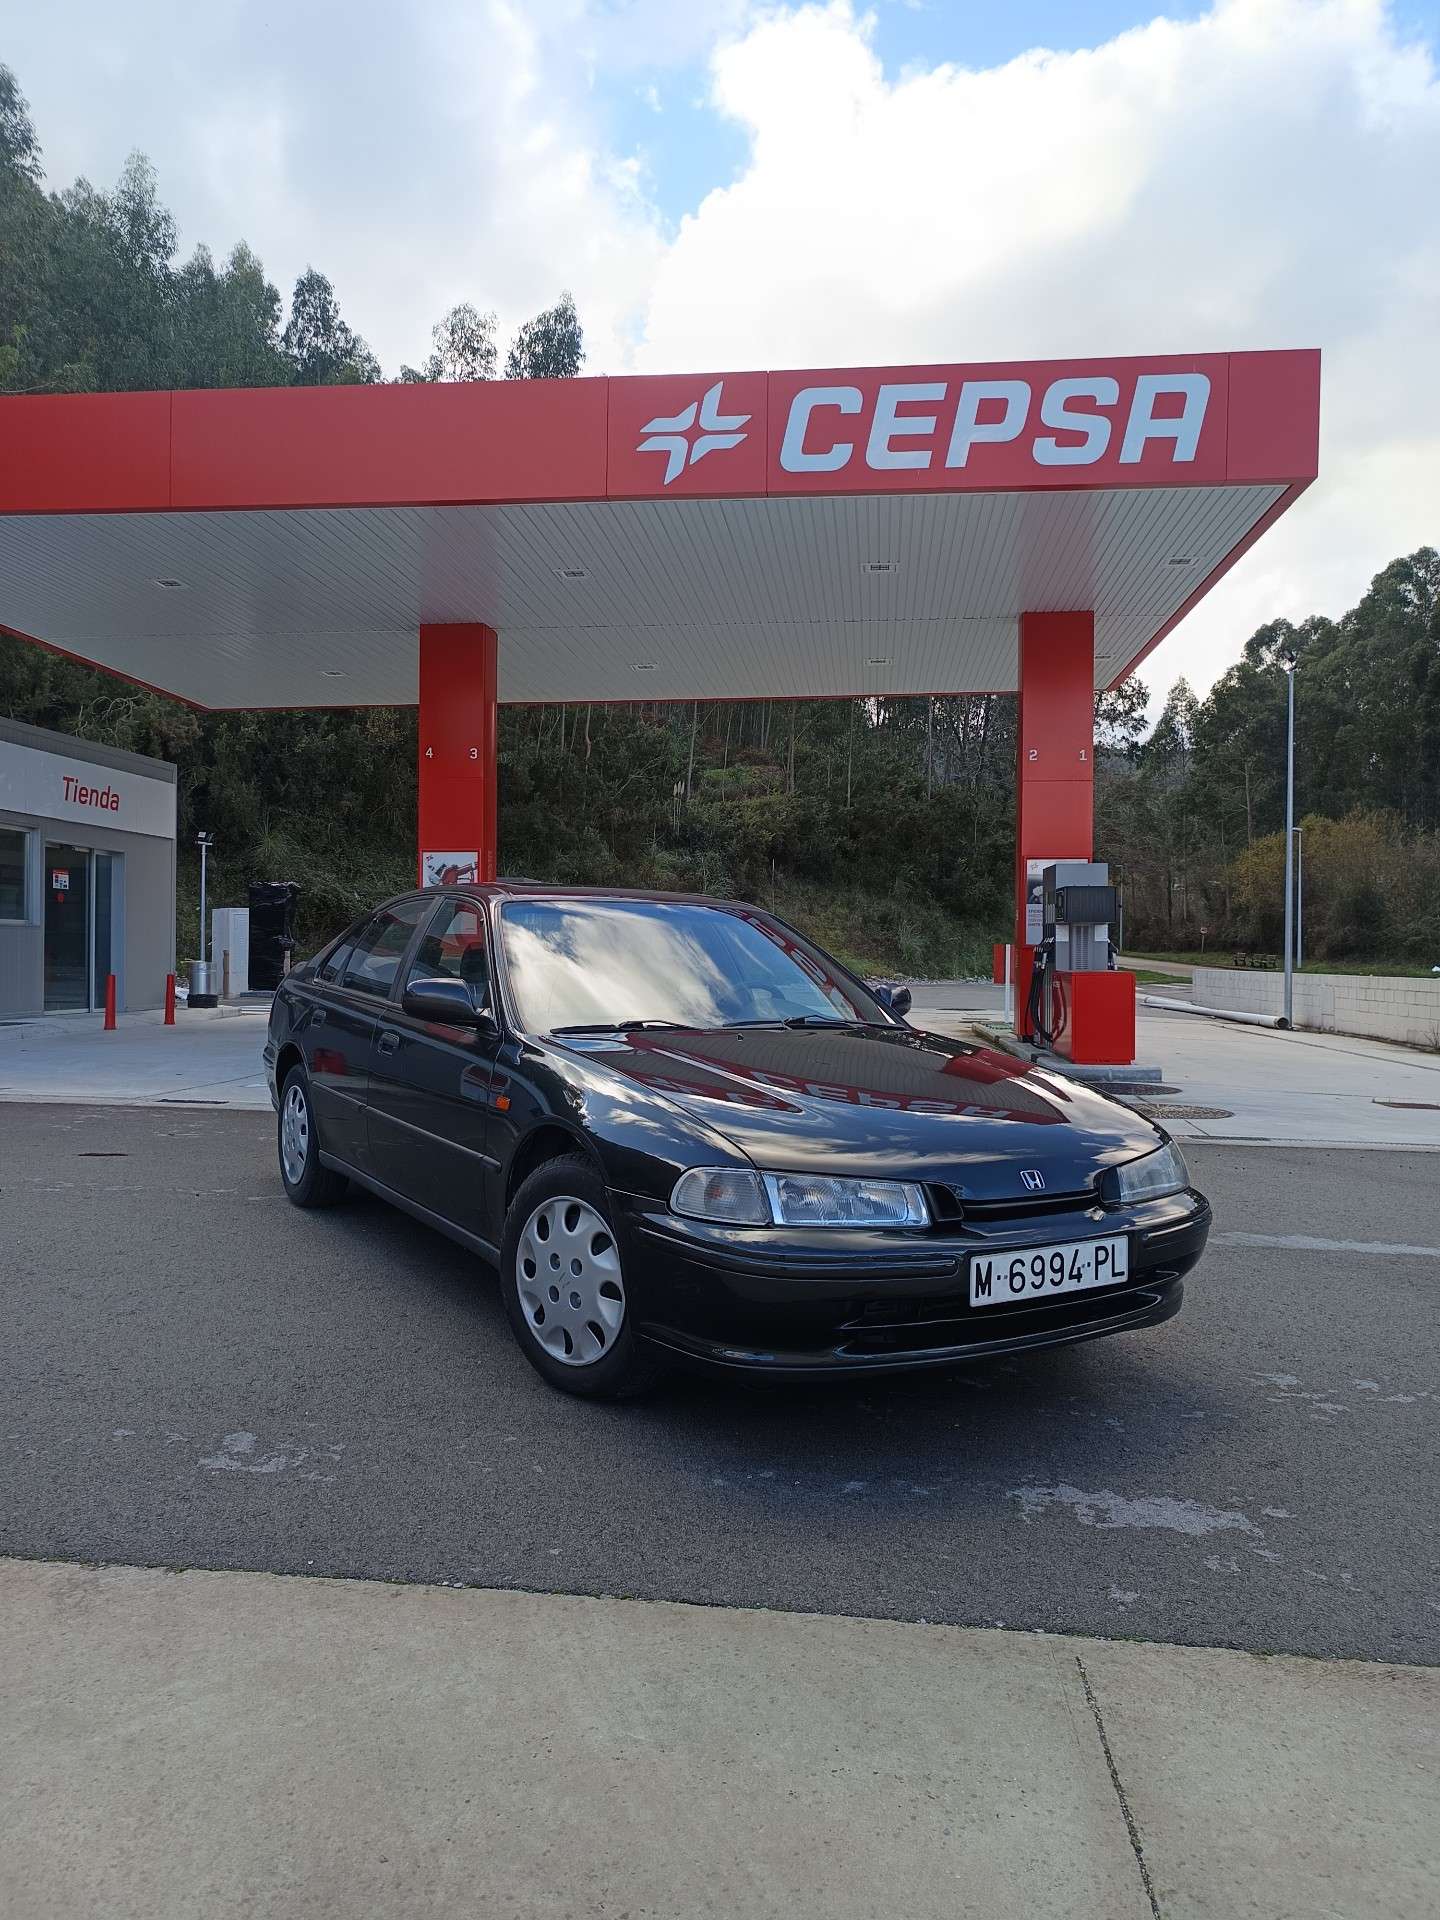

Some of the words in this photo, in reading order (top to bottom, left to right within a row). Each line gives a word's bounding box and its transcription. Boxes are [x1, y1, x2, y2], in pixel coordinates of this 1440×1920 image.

[779, 373, 1211, 473] CEPSA
[425, 747, 434, 758] 4
[469, 747, 478, 759] 3
[1029, 749, 1038, 761] 2
[1079, 749, 1088, 761] 1
[63, 776, 120, 811] Tienda
